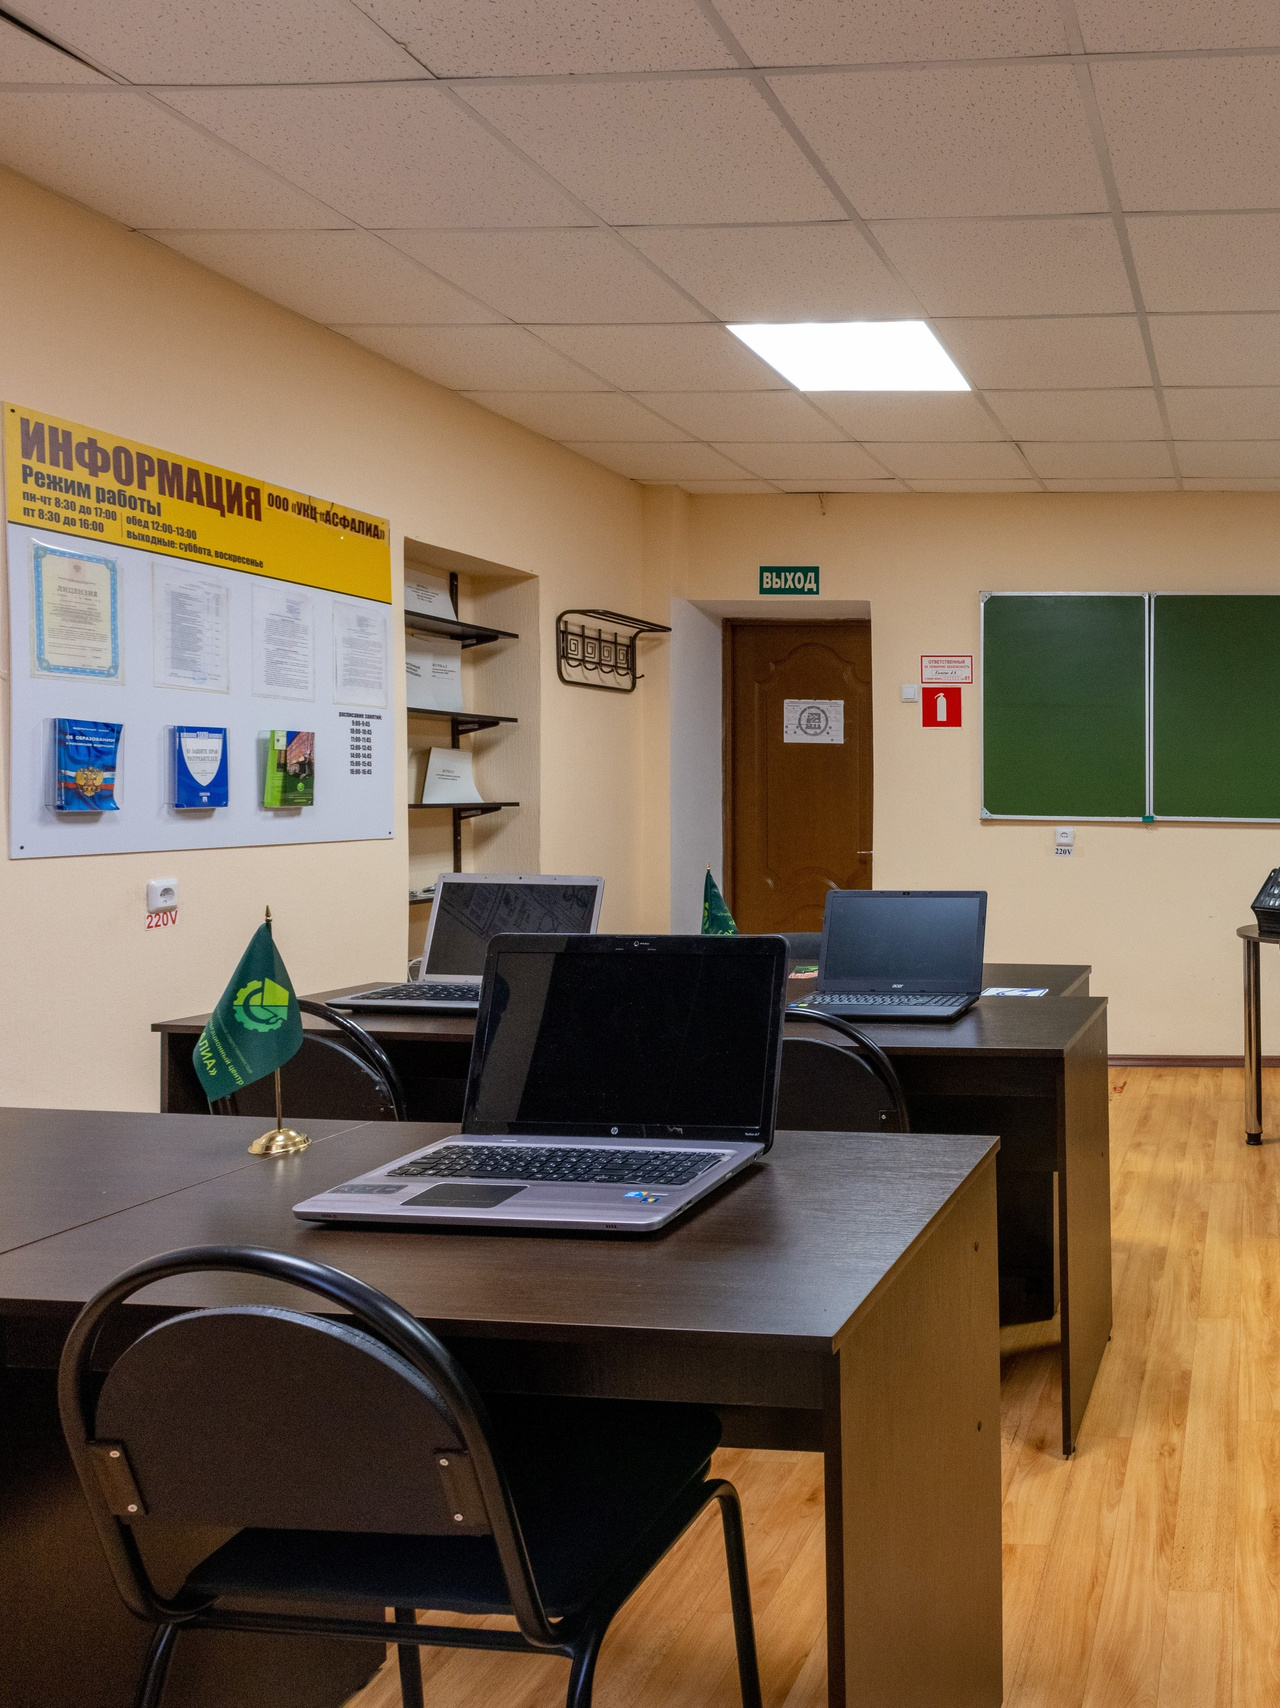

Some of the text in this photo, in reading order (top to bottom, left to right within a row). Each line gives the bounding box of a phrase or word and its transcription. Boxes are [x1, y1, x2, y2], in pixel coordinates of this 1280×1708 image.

[20, 417, 262, 522] ИНФОРМАЦИЯ
[22, 464, 162, 517] Режим работы
[22, 491, 117, 522] пн-чт 8:30 до 17:00
[23, 506, 104, 532] пт 8:30 до 16:00
[268, 492, 288, 512] ООО
[320, 510, 385, 540] «АСФАЛИА»
[126, 516, 197, 540] обед 12:00-13:00
[126, 530, 264, 568] выходные: суббота, воскресенье
[57, 585, 98, 597] ЛИЦЕНЗИЯ
[763, 572, 816, 592] ВЫХОД
[146, 910, 178, 929] 220V
[228, 1064, 244, 1086] центр
